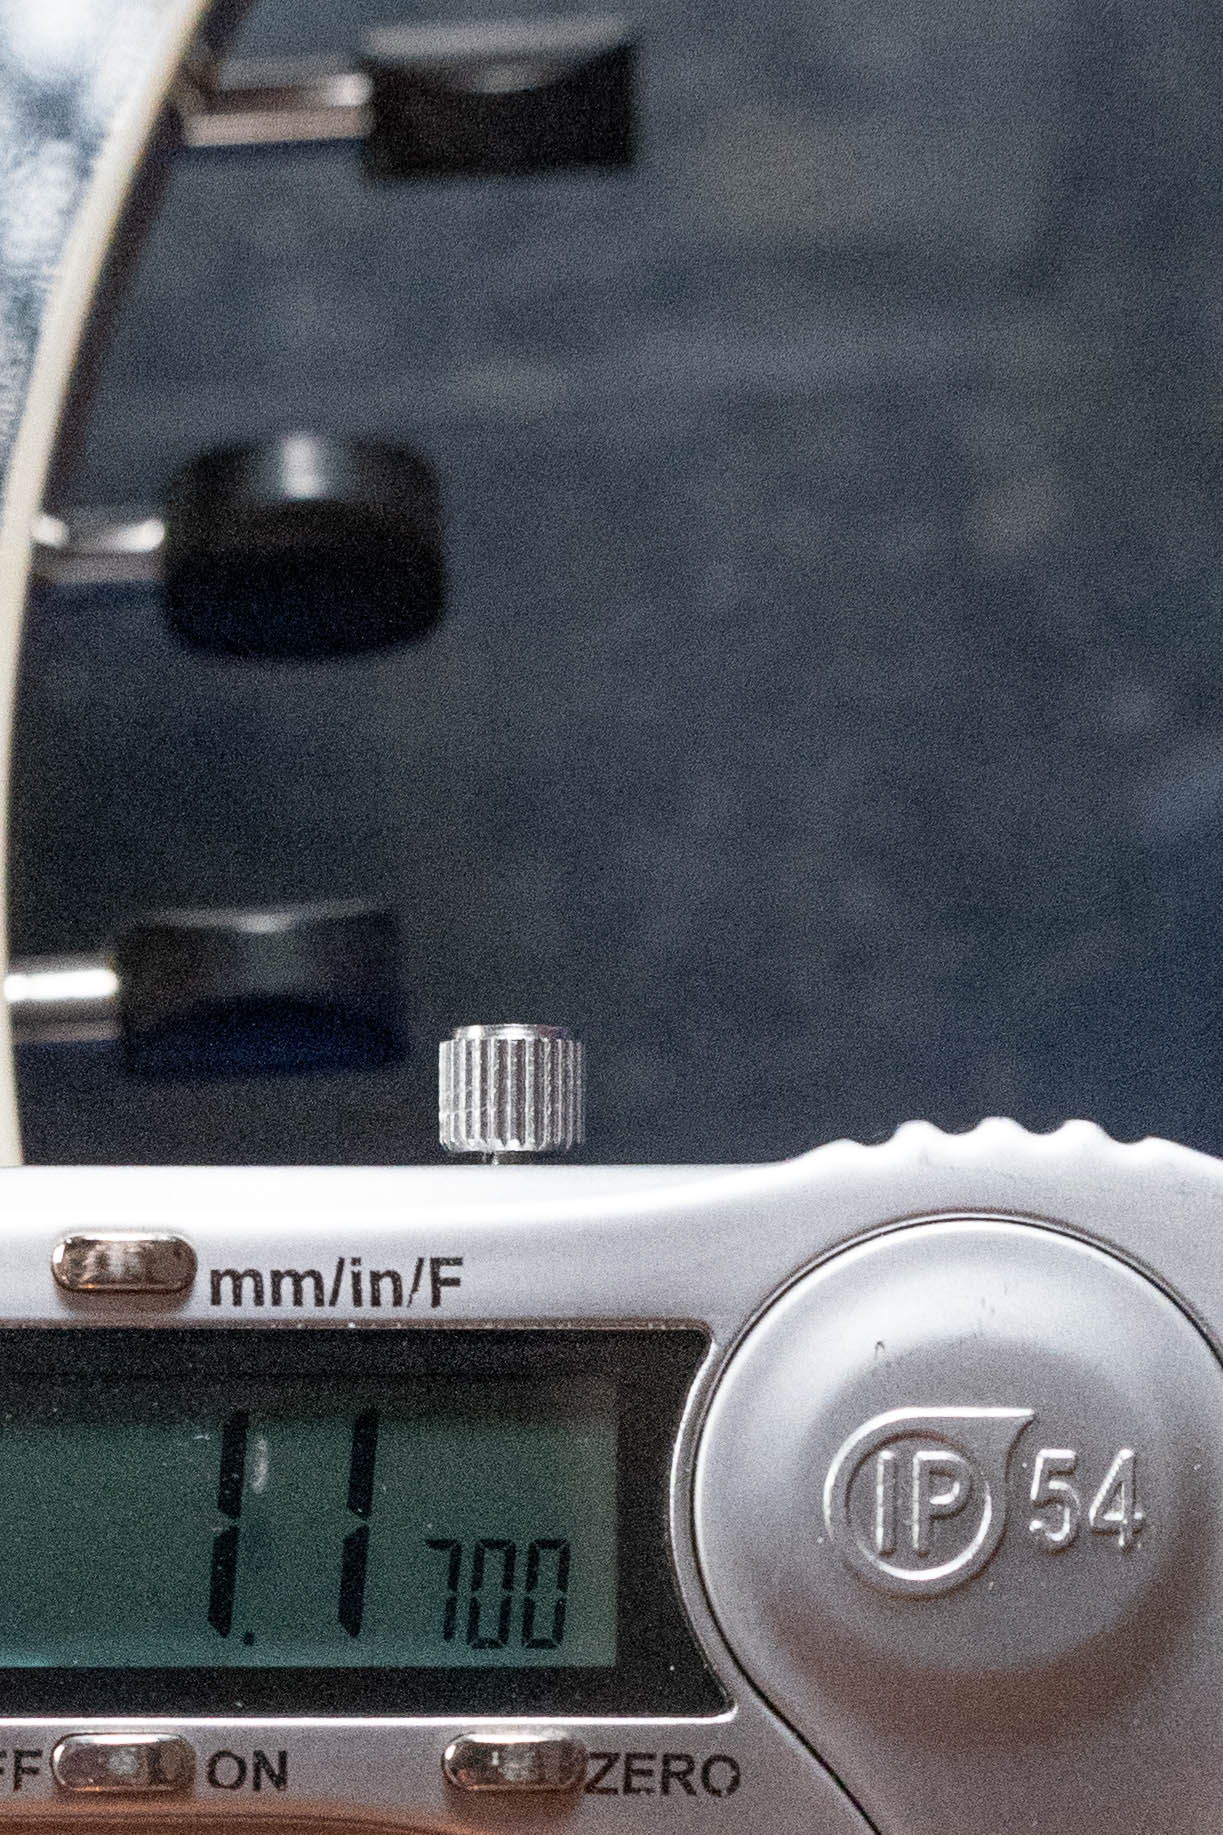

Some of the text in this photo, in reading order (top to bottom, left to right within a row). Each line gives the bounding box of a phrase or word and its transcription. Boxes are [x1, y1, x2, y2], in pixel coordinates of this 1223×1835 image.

[210, 1256, 464, 1309] mm/in/F
[877, 1448, 1145, 1557] IP 54
[205, 1748, 289, 1794] ON
[582, 1750, 741, 1799] ZERO
